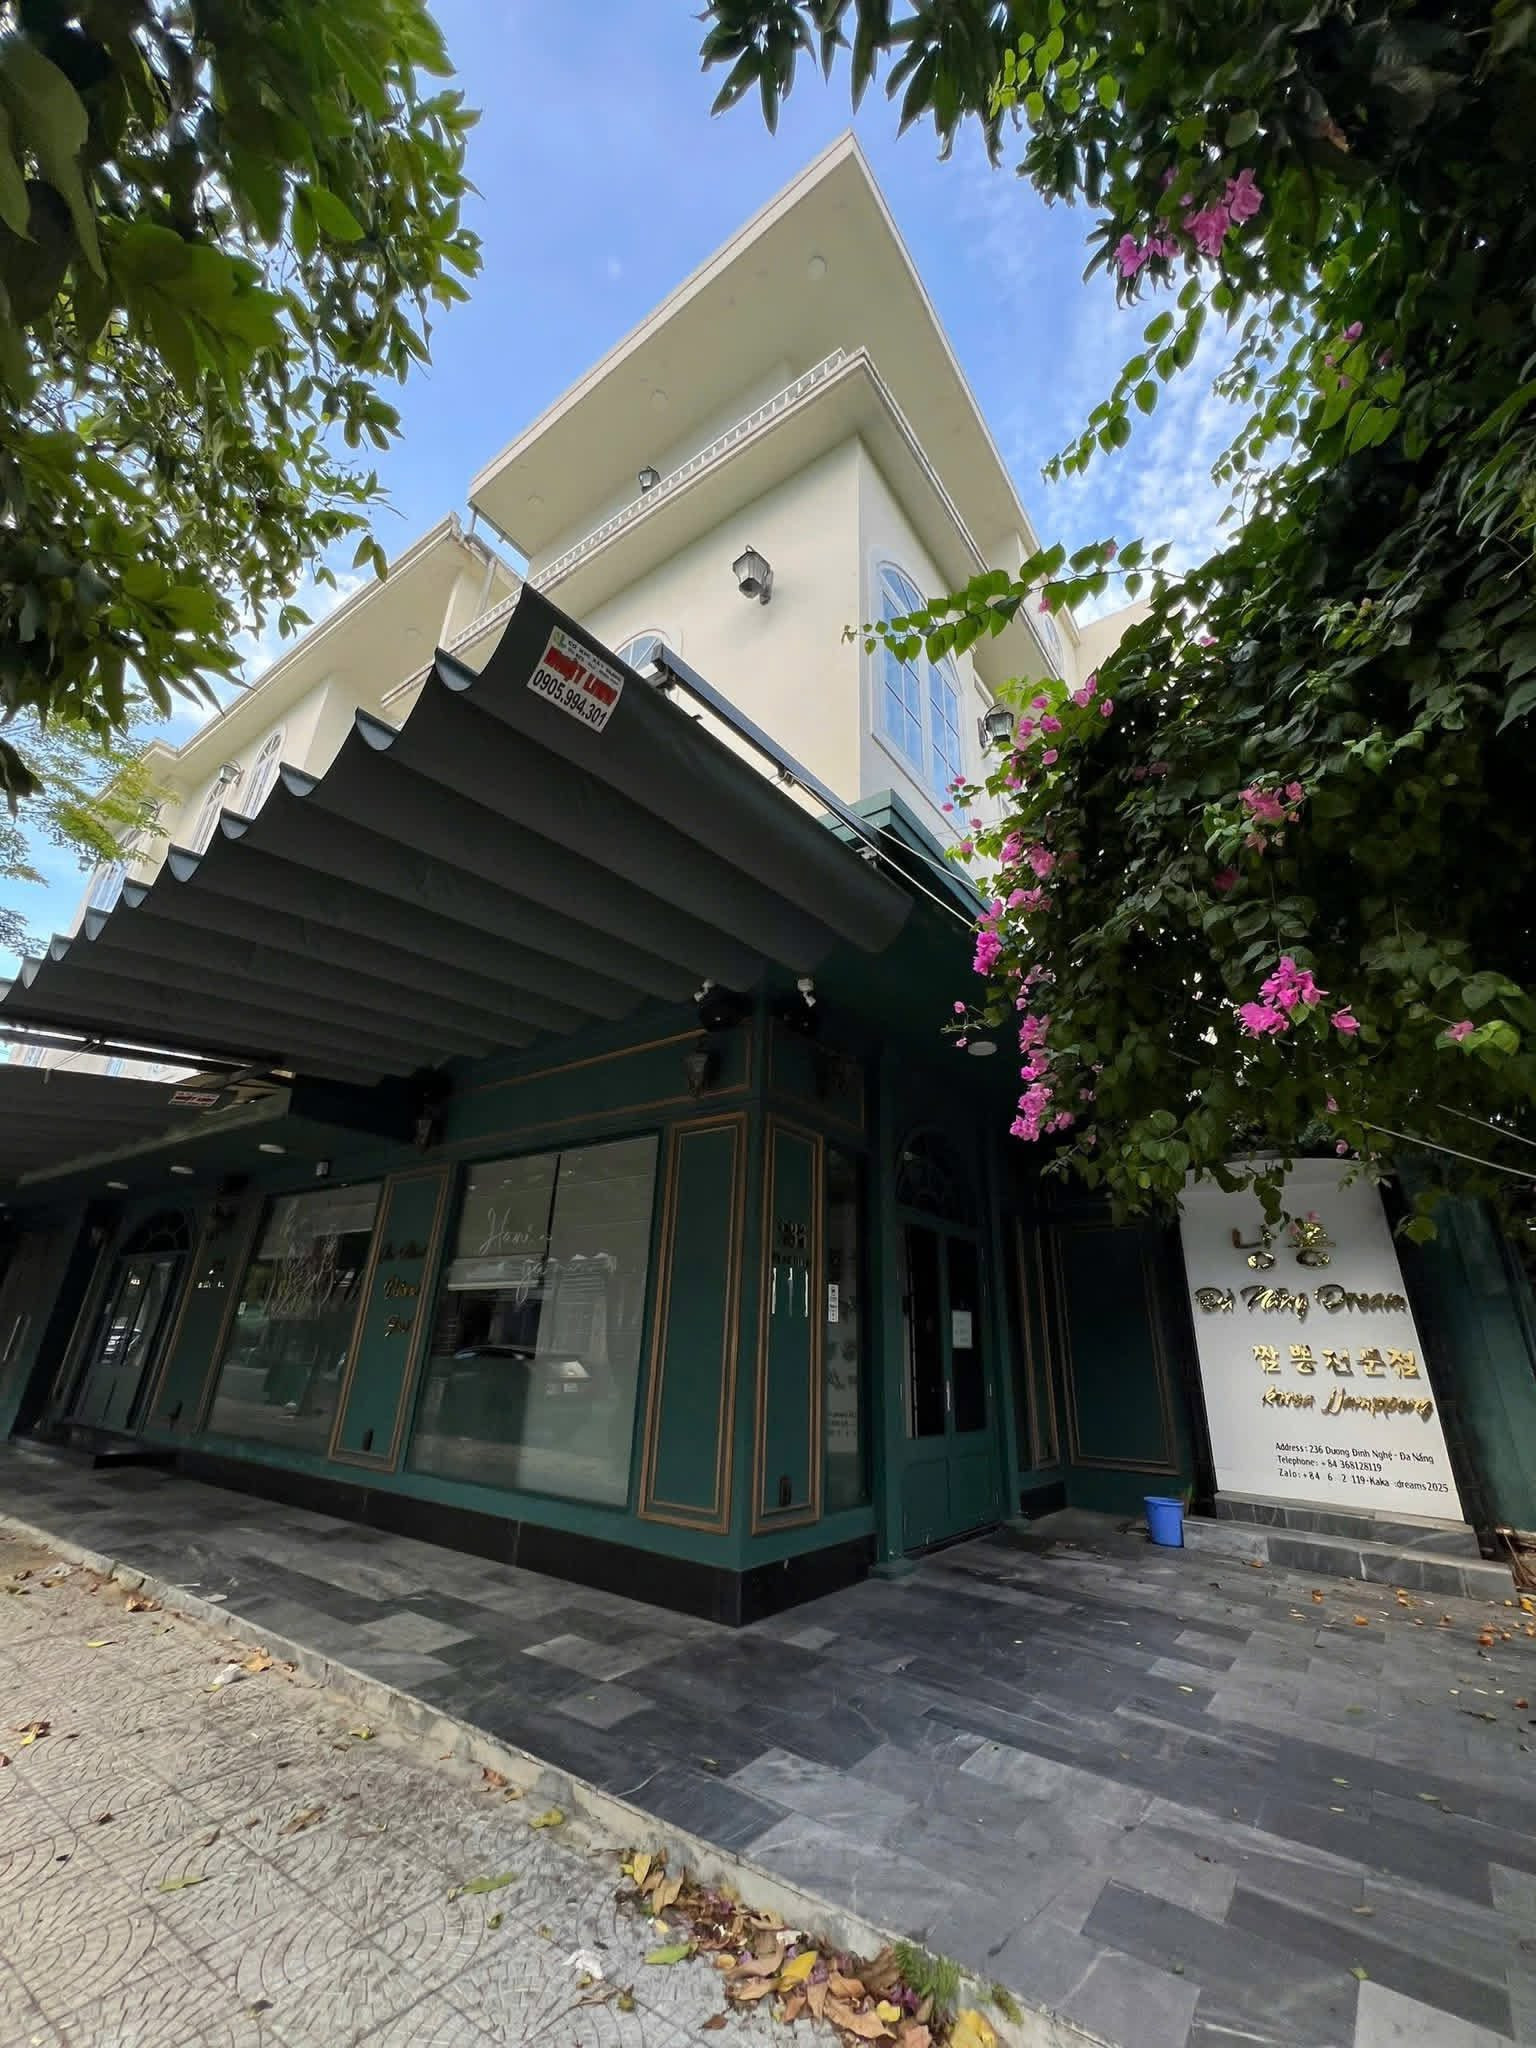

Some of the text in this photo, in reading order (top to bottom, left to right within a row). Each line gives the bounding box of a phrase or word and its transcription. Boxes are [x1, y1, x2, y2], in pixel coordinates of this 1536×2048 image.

[532, 669, 608, 727] 0905.994.301
[1309, 1444, 1324, 1455] 236
[1339, 1460, 1382, 1473] 368128119
